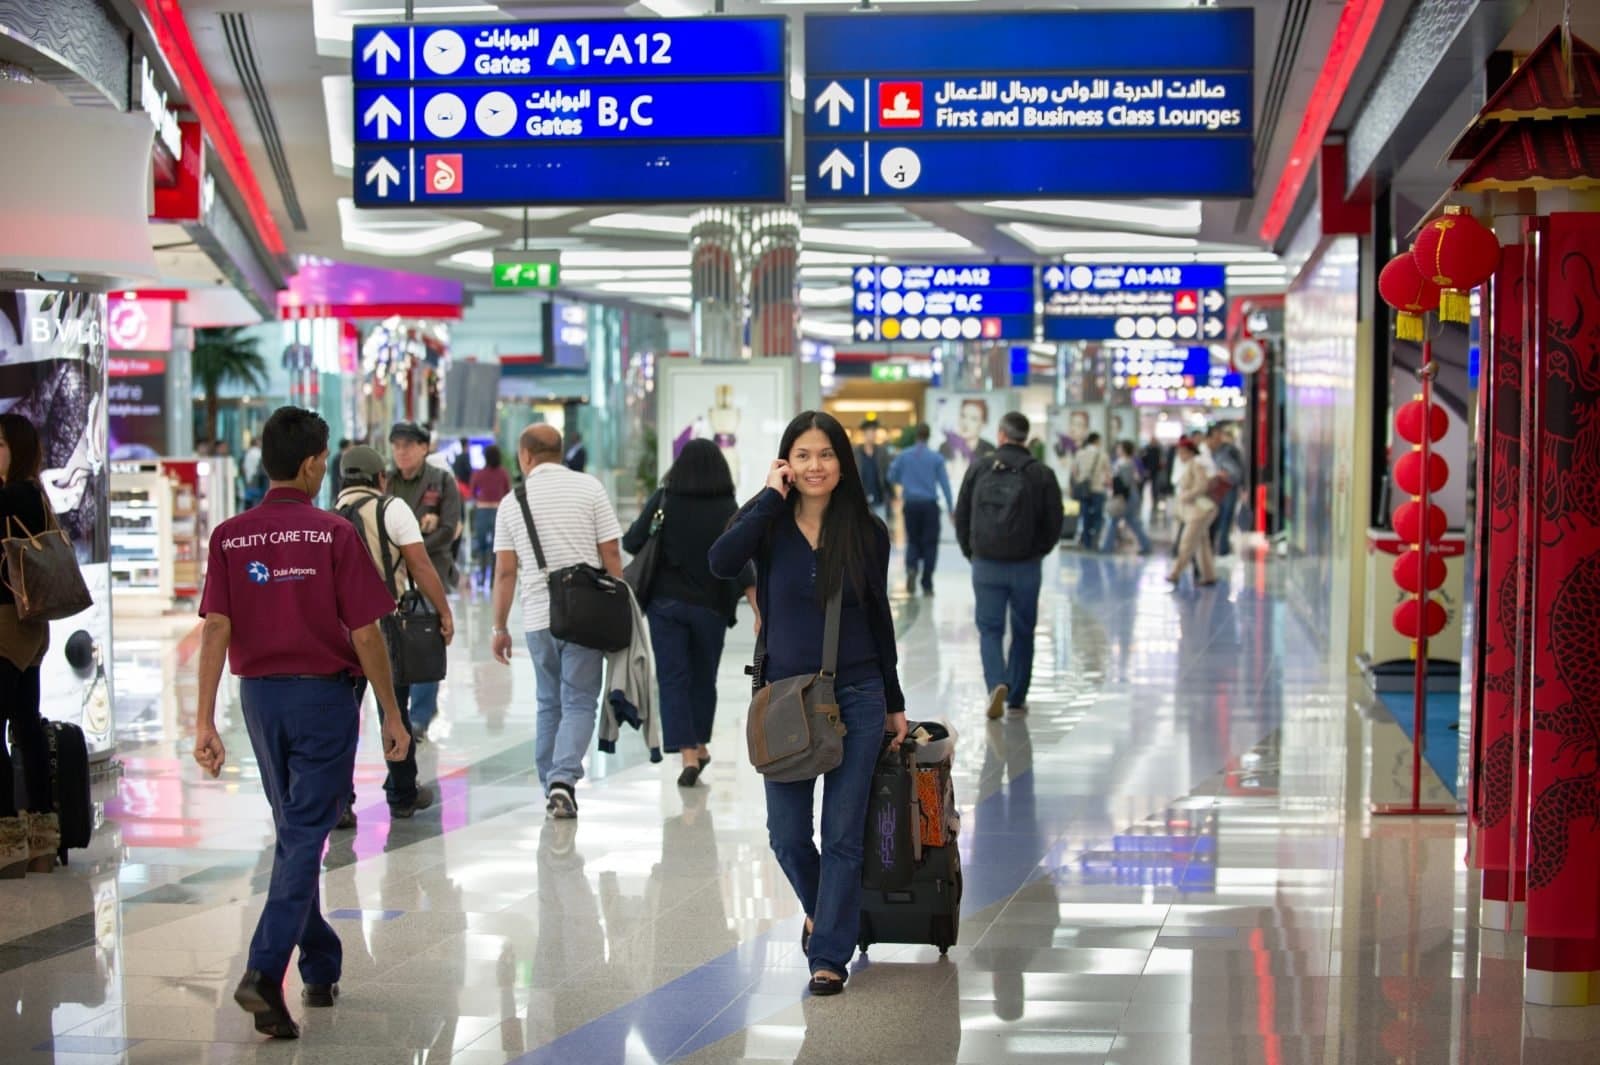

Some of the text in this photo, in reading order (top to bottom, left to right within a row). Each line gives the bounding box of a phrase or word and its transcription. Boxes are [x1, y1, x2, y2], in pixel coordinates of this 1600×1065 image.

[474, 28, 540, 51] البوابات
[546, 32, 673, 66] A1-A12
[474, 54, 532, 75] Gates
[1000, 80, 1049, 104] ورجال
[1112, 79, 1164, 102] الدرجة
[1166, 79, 1226, 99] صالات
[525, 89, 591, 112] البوابات
[598, 95, 654, 131] B,C
[936, 105, 1241, 130] First and Business Class Lounges
[526, 116, 583, 136] Gates
[933, 268, 991, 286] A1-A12
[1124, 267, 1182, 285] A1-A12
[221, 533, 267, 550] FACILITY
[269, 530, 301, 544] CARE
[288, 567, 317, 577] Airports
